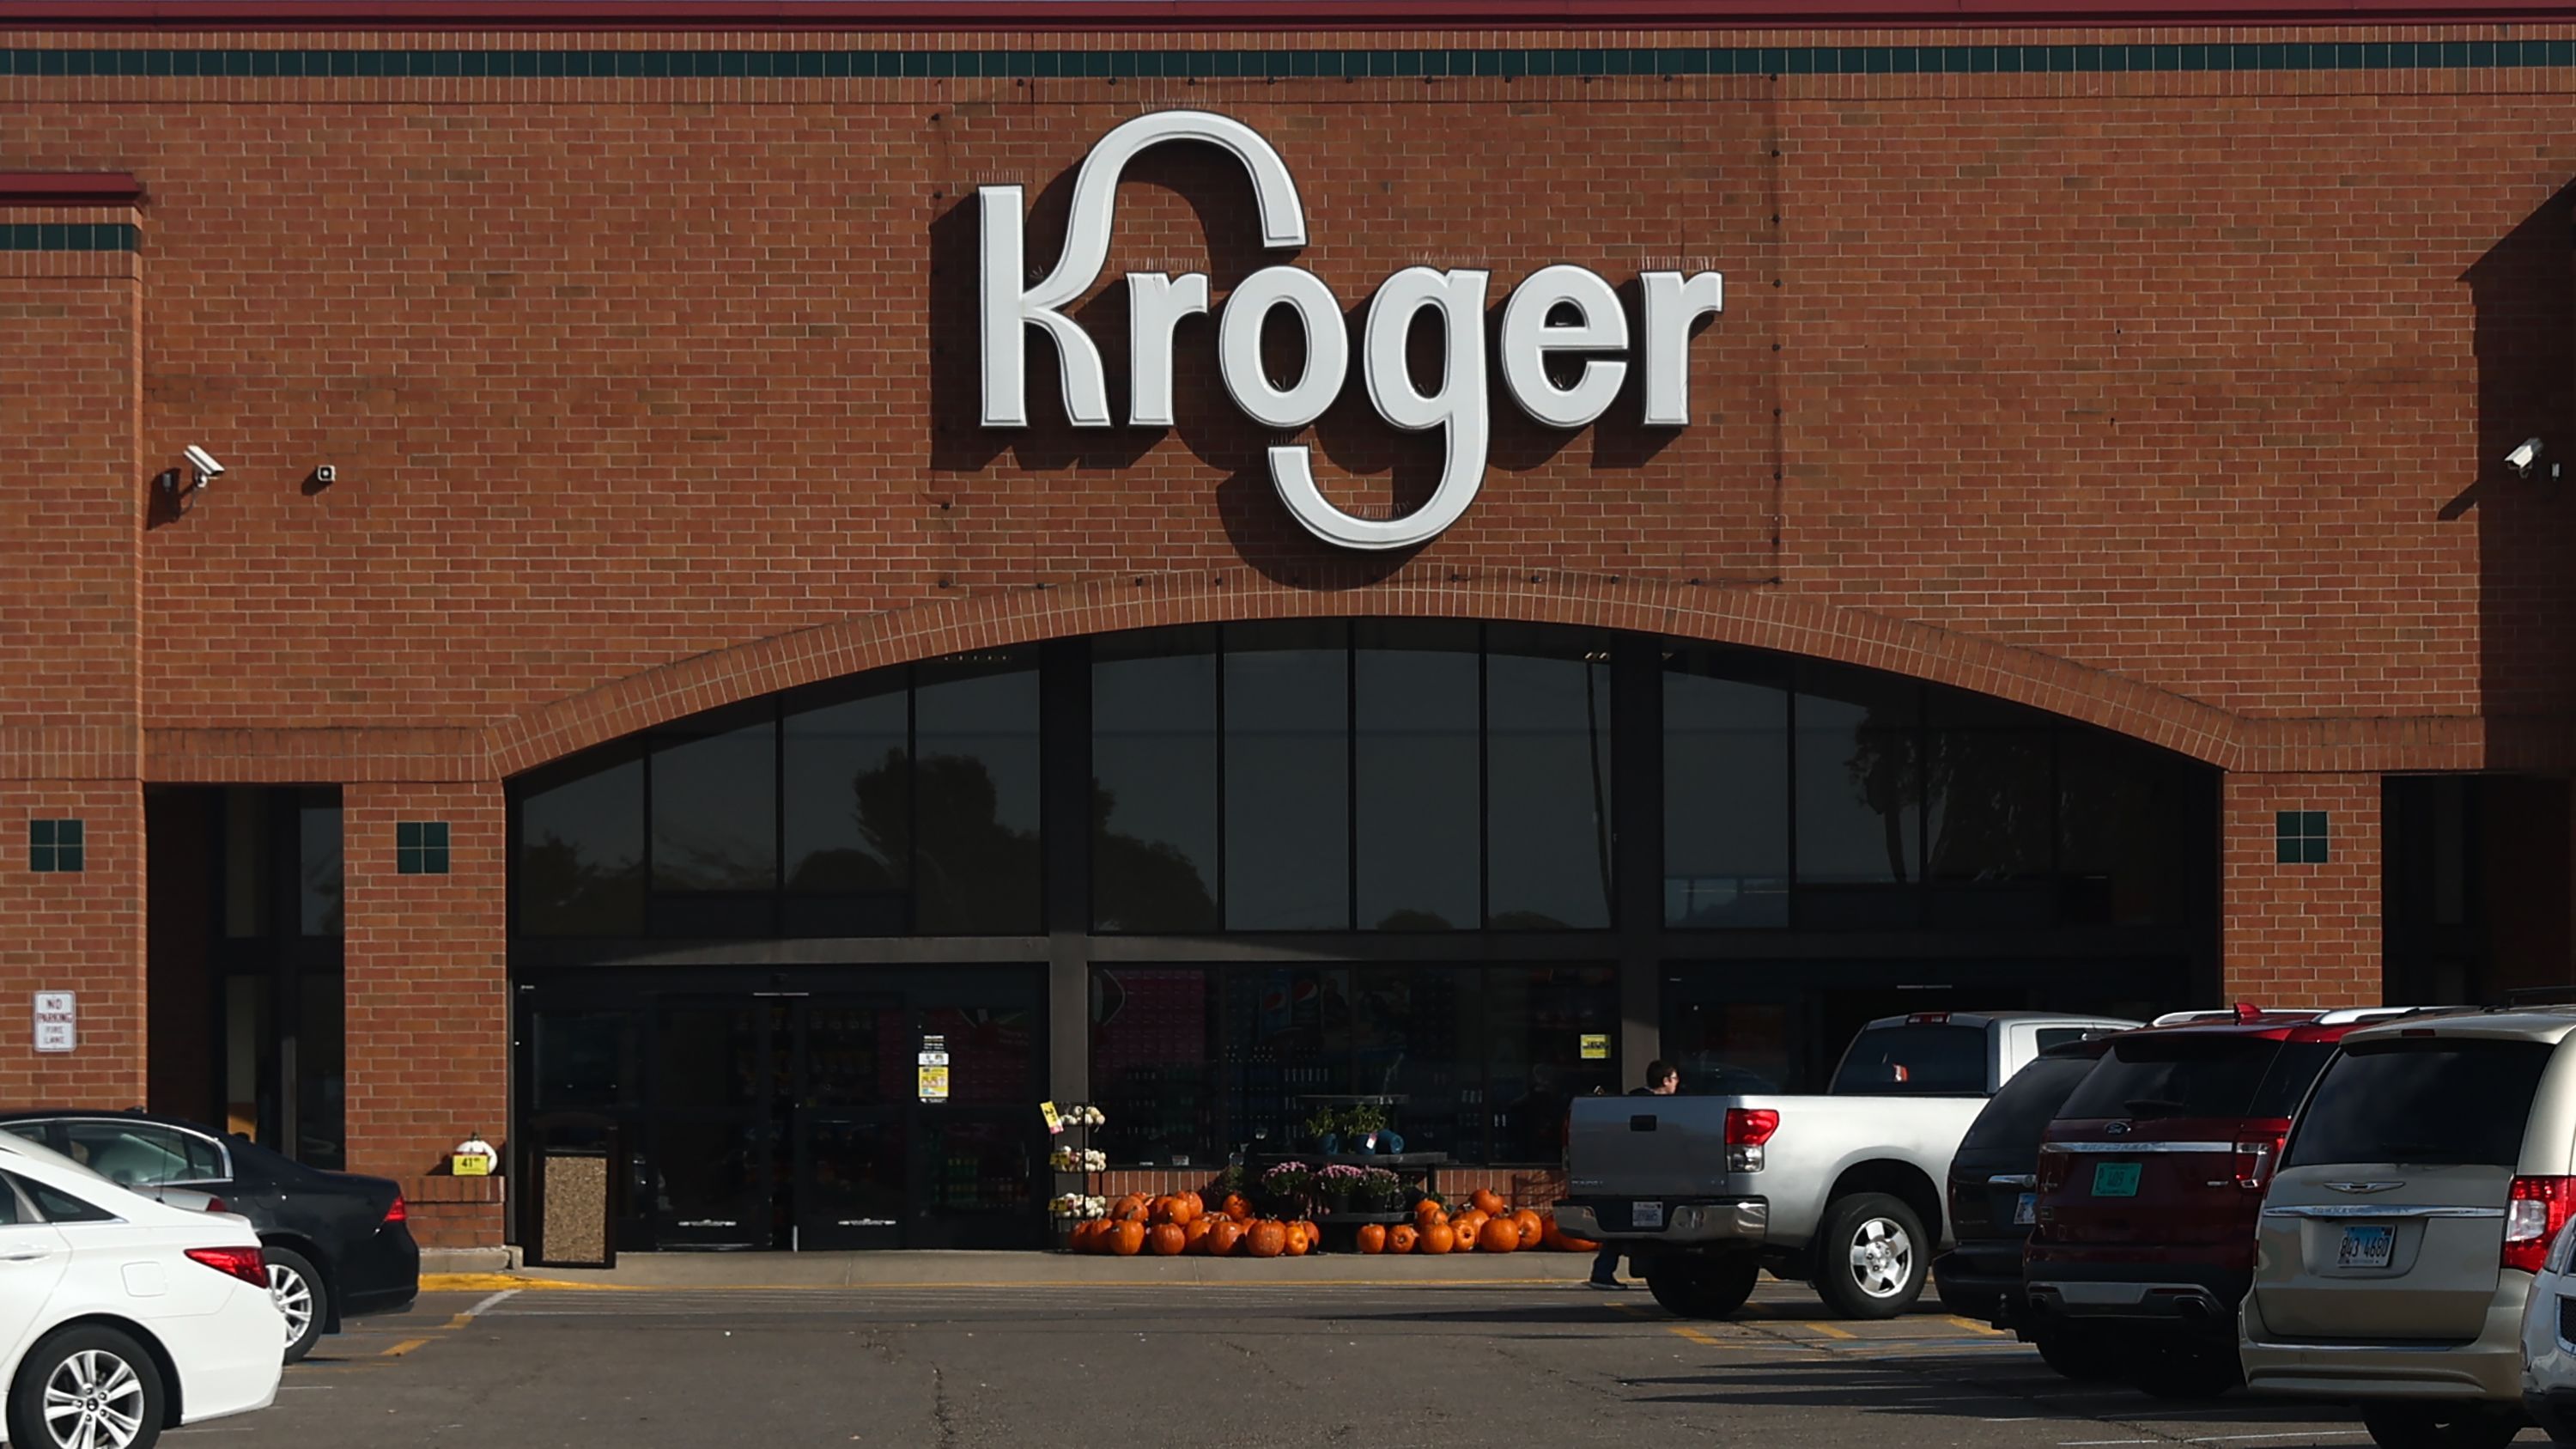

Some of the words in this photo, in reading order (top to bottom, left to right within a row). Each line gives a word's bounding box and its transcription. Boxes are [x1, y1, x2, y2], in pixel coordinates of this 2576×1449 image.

[978, 109, 1724, 551] Kroger
[47, 999, 63, 1010] NO
[37, 1013, 73, 1023] PARKING
